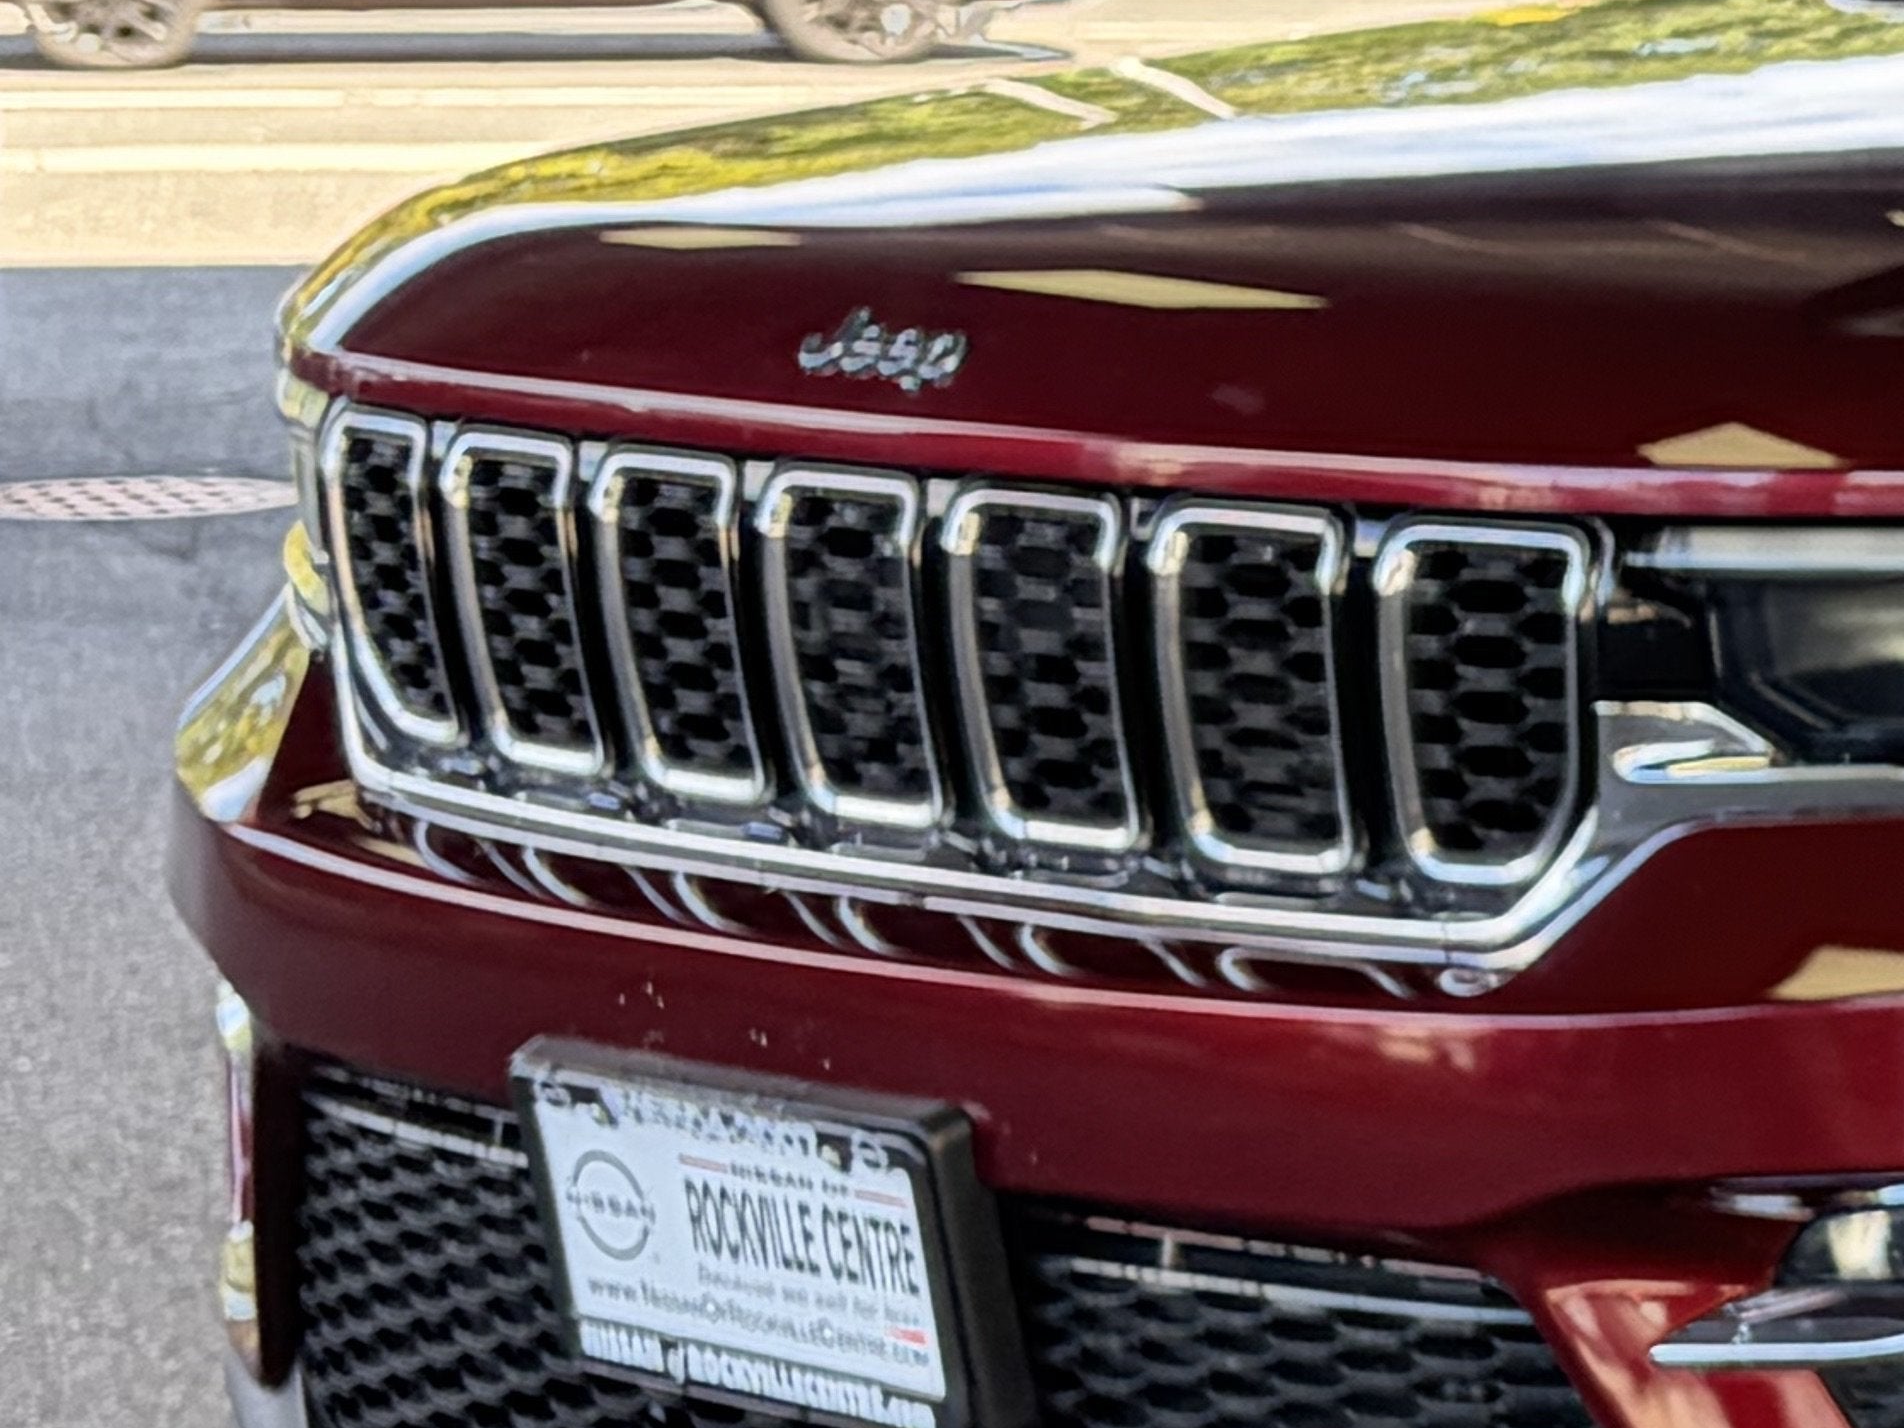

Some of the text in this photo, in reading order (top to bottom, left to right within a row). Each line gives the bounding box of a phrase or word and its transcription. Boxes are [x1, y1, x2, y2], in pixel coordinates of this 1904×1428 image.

[798, 306, 967, 393] Jeep
[684, 1176, 920, 1298] ROCKVILLE CENTRE
